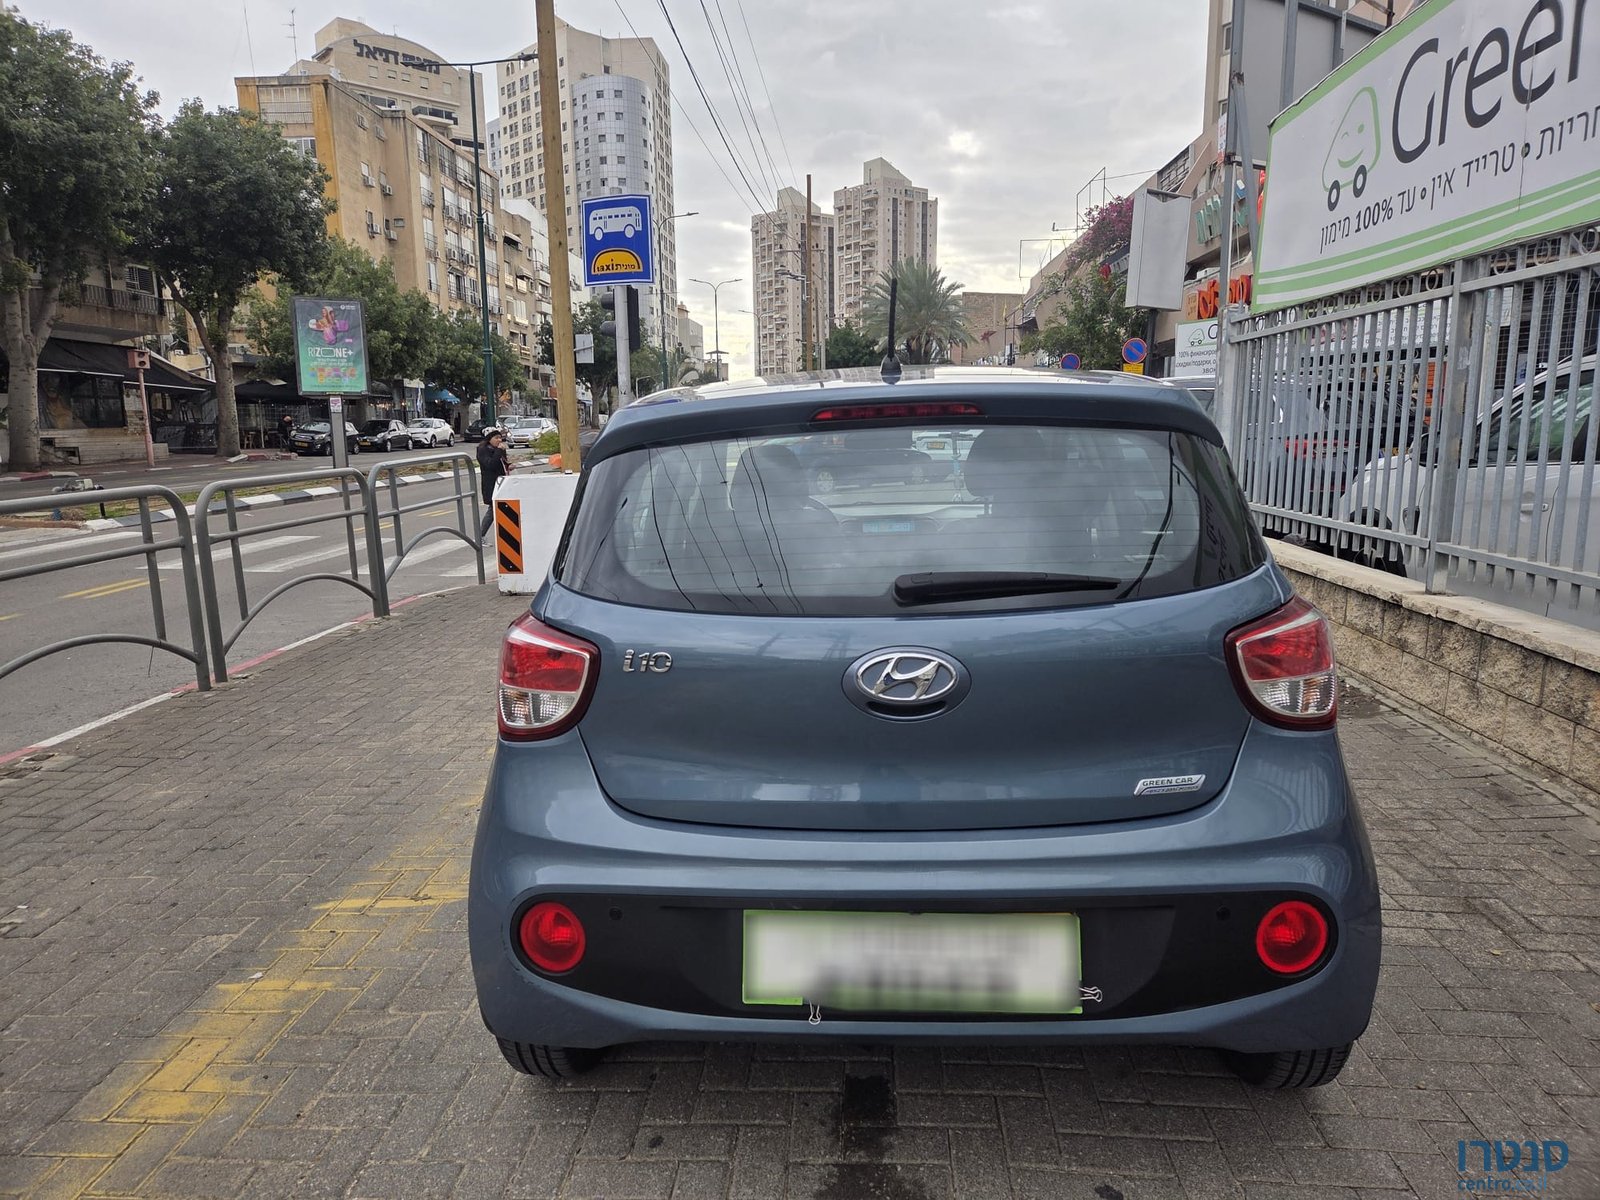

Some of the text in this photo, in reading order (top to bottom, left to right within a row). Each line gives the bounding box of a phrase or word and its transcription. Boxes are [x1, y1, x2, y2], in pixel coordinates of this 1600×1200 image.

[353, 39, 400, 65] דניאל
[1462, 142, 1516, 187] טרייד
[1397, 186, 1416, 215] עד
[1430, 167, 1456, 210] אין
[1354, 196, 1394, 234] 100%
[1319, 216, 1351, 254] מימון
[596, 258, 614, 272] taxi
[622, 648, 673, 673] i10
[1143, 778, 1173, 786] GREEN
